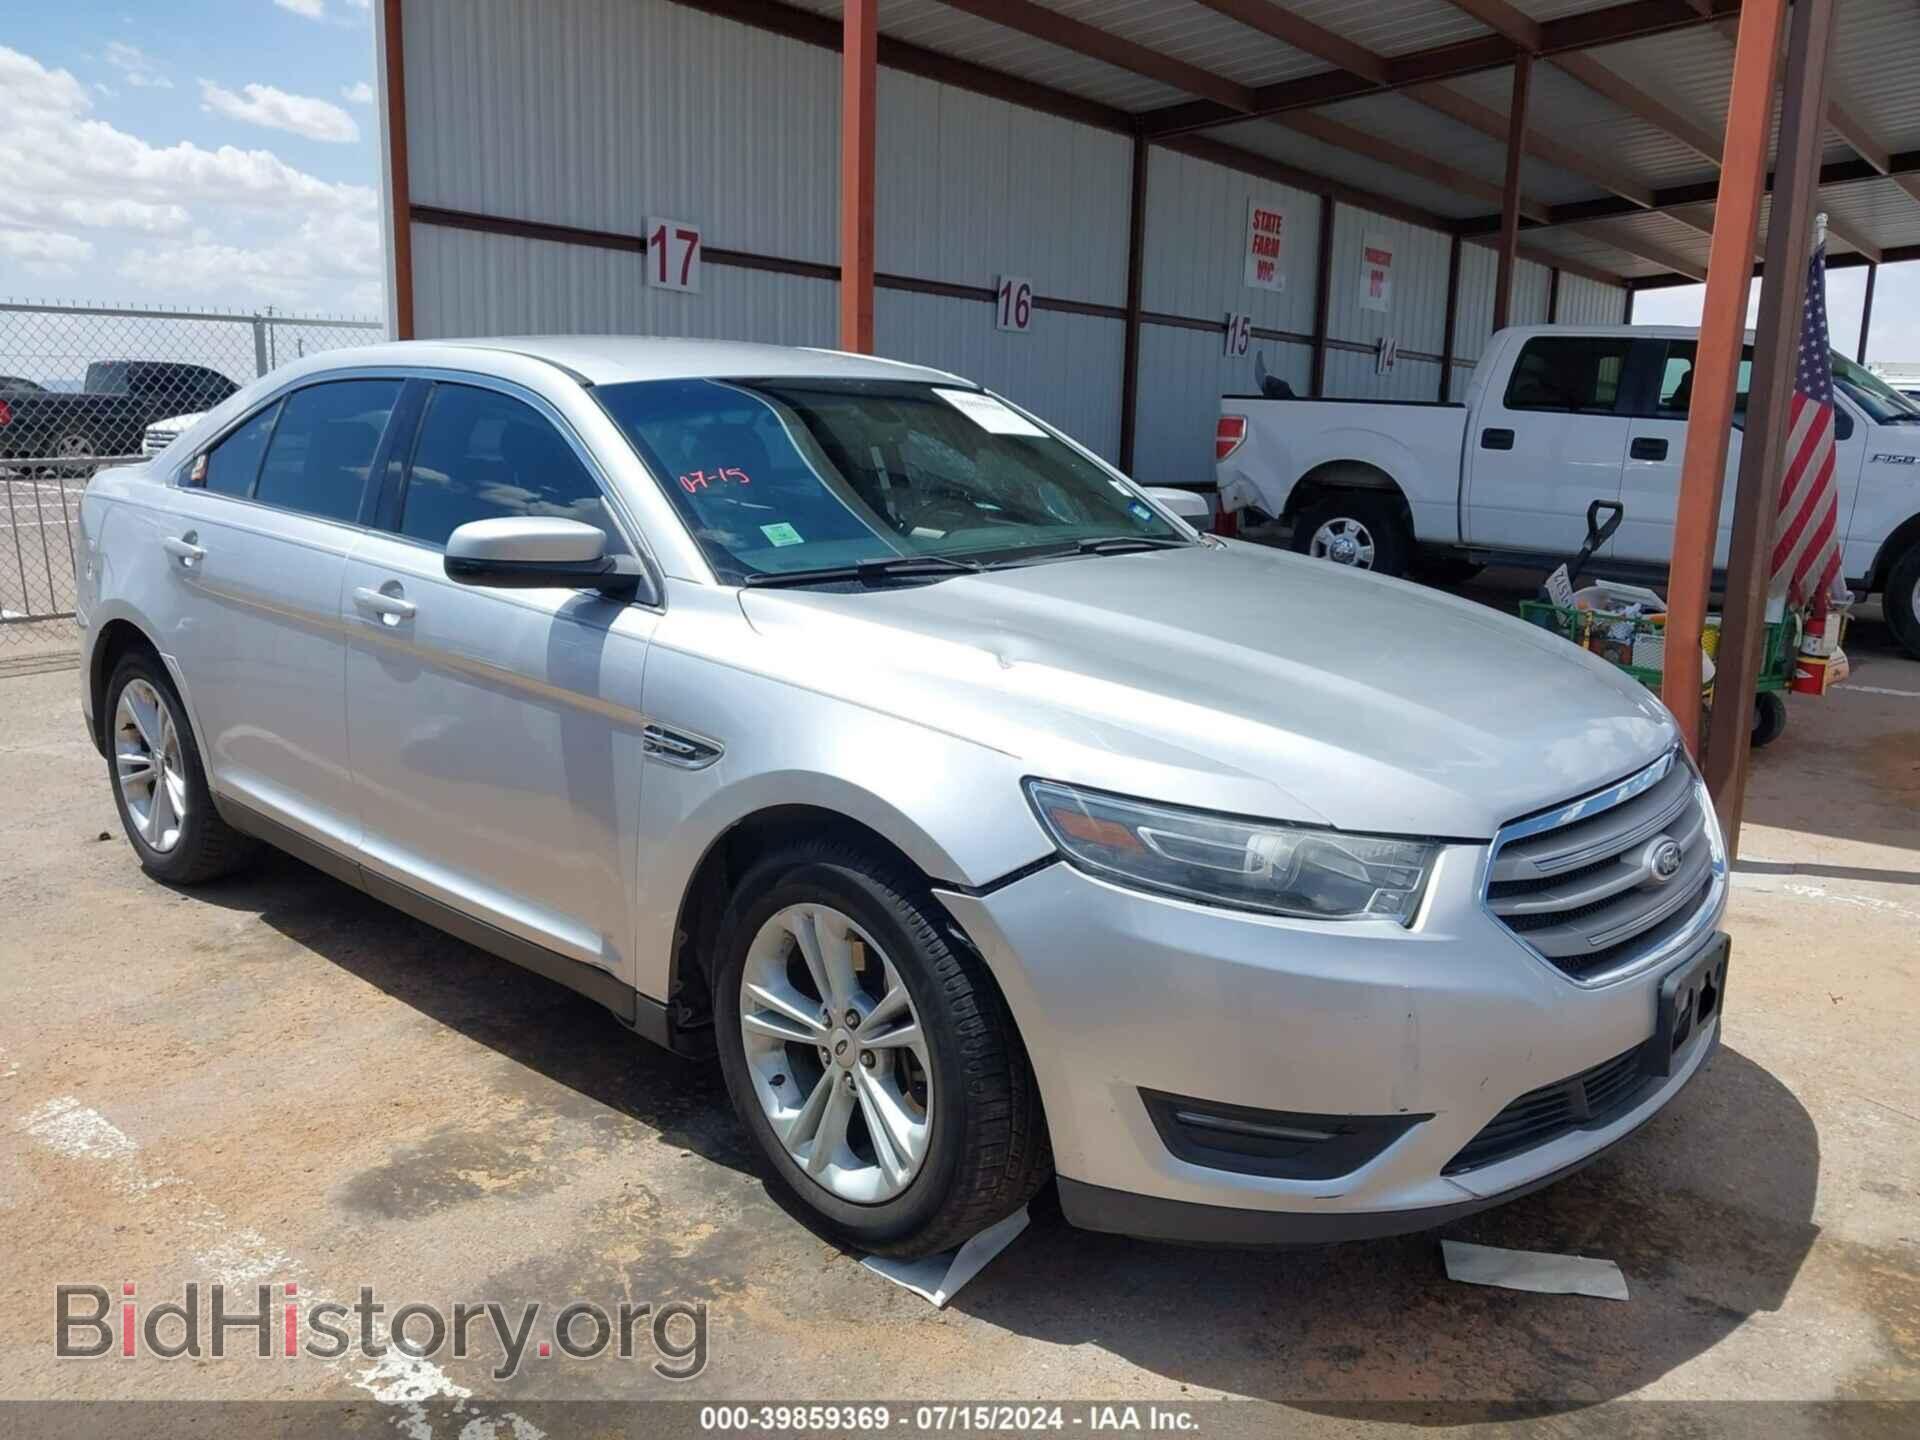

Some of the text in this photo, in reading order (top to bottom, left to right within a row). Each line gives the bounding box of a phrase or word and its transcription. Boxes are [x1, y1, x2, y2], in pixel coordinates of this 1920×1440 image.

[1252, 208, 1282, 234] STATE
[650, 225, 699, 286] 17
[1252, 234, 1281, 258] FARM
[1001, 280, 1030, 329] 16
[1230, 315, 1250, 355] 15
[1381, 339, 1396, 372] 14
[680, 467, 750, 493] 07-15
